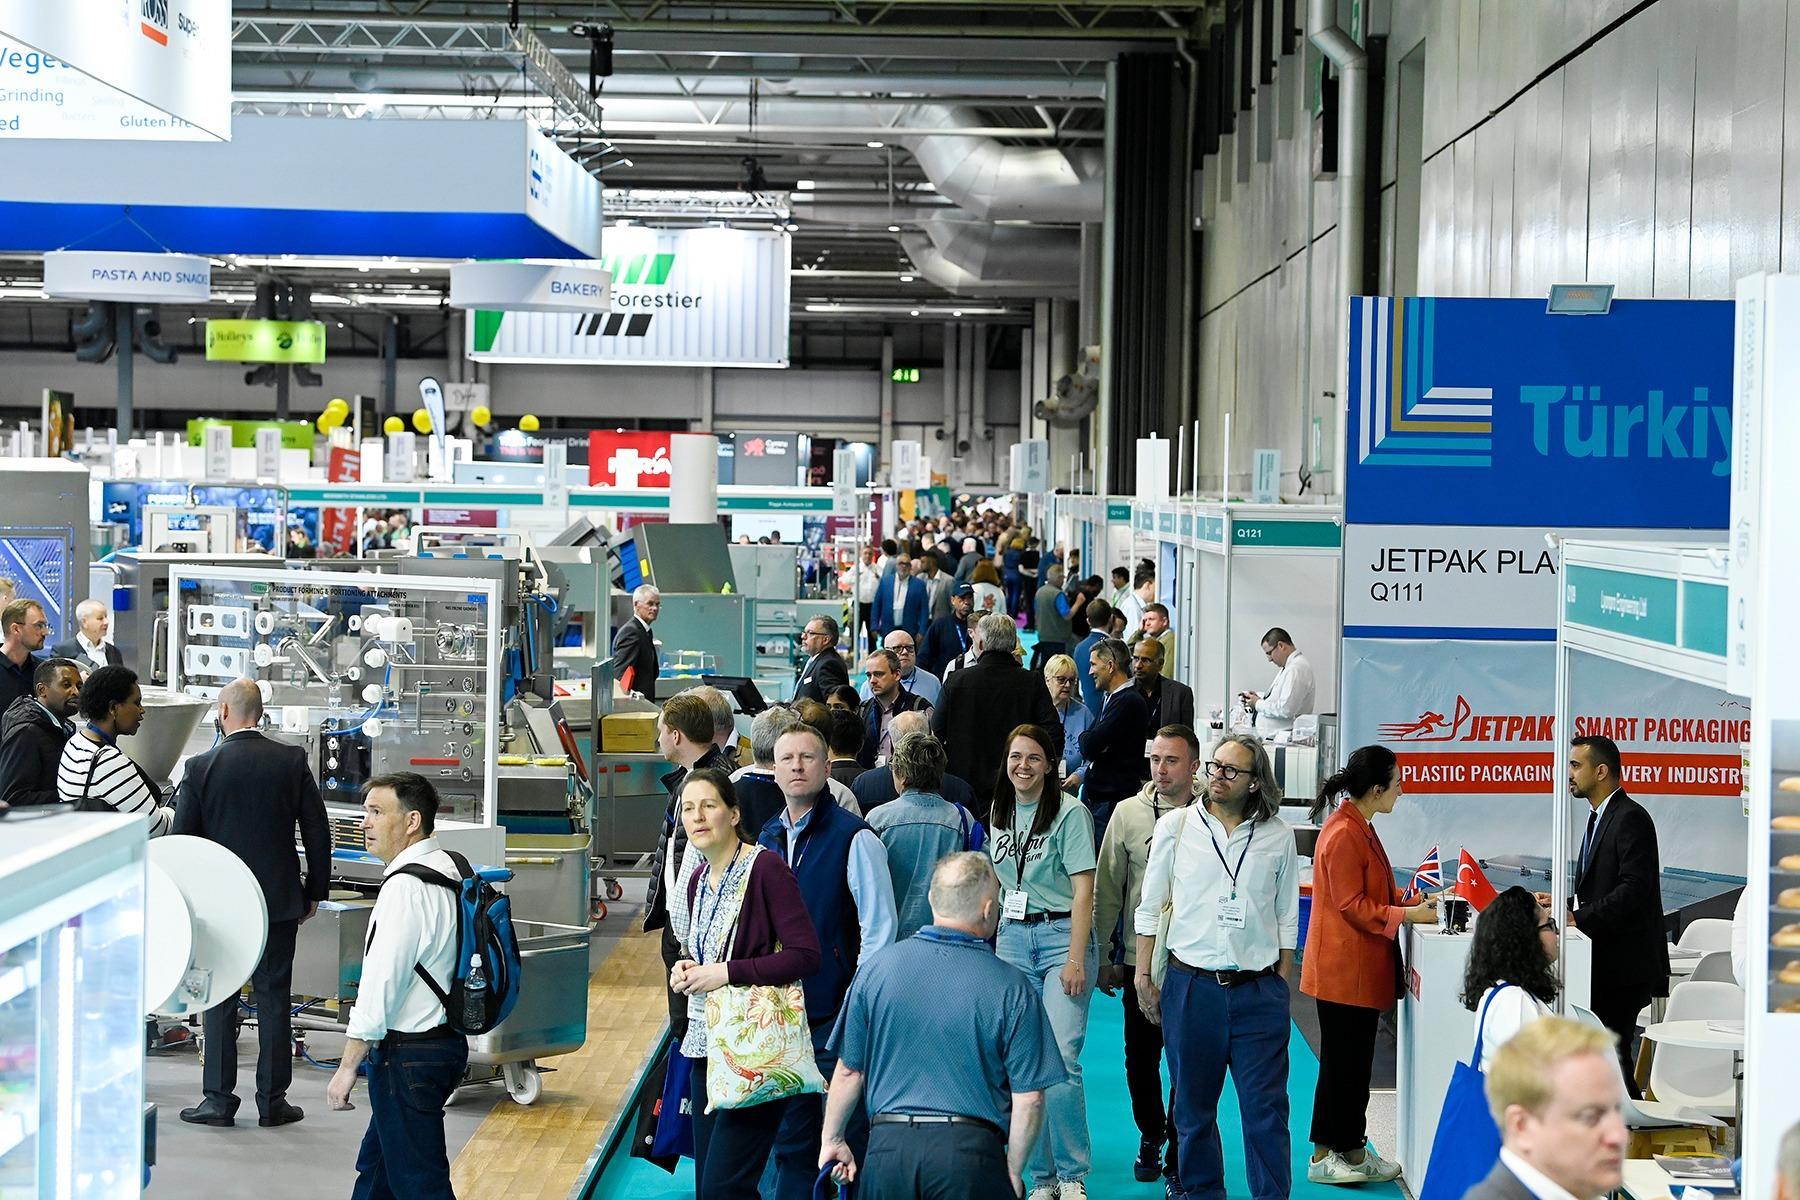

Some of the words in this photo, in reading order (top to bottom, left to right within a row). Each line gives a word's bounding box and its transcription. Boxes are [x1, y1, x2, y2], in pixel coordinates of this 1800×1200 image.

[120, 115, 166, 127] Gluten
[92, 269, 137, 280] PASTA
[142, 271, 172, 282] AND
[551, 281, 604, 296] BAKERY
[1237, 528, 1262, 538] Q121
[1371, 548, 1487, 573] JETPAK
[1497, 550, 1559, 575] PLA
[299, 587, 324, 595] FORMING
[330, 588, 366, 597] PORTIONING
[366, 590, 407, 599] ATTACHMENTS
[1370, 582, 1423, 602] Q111
[1460, 715, 1555, 742] JETPAK
[1575, 716, 1638, 742] SMART
[1644, 718, 1750, 743] PACKAGING
[1402, 765, 1466, 782] PLASTIC
[993, 831, 1049, 865] Beloir
